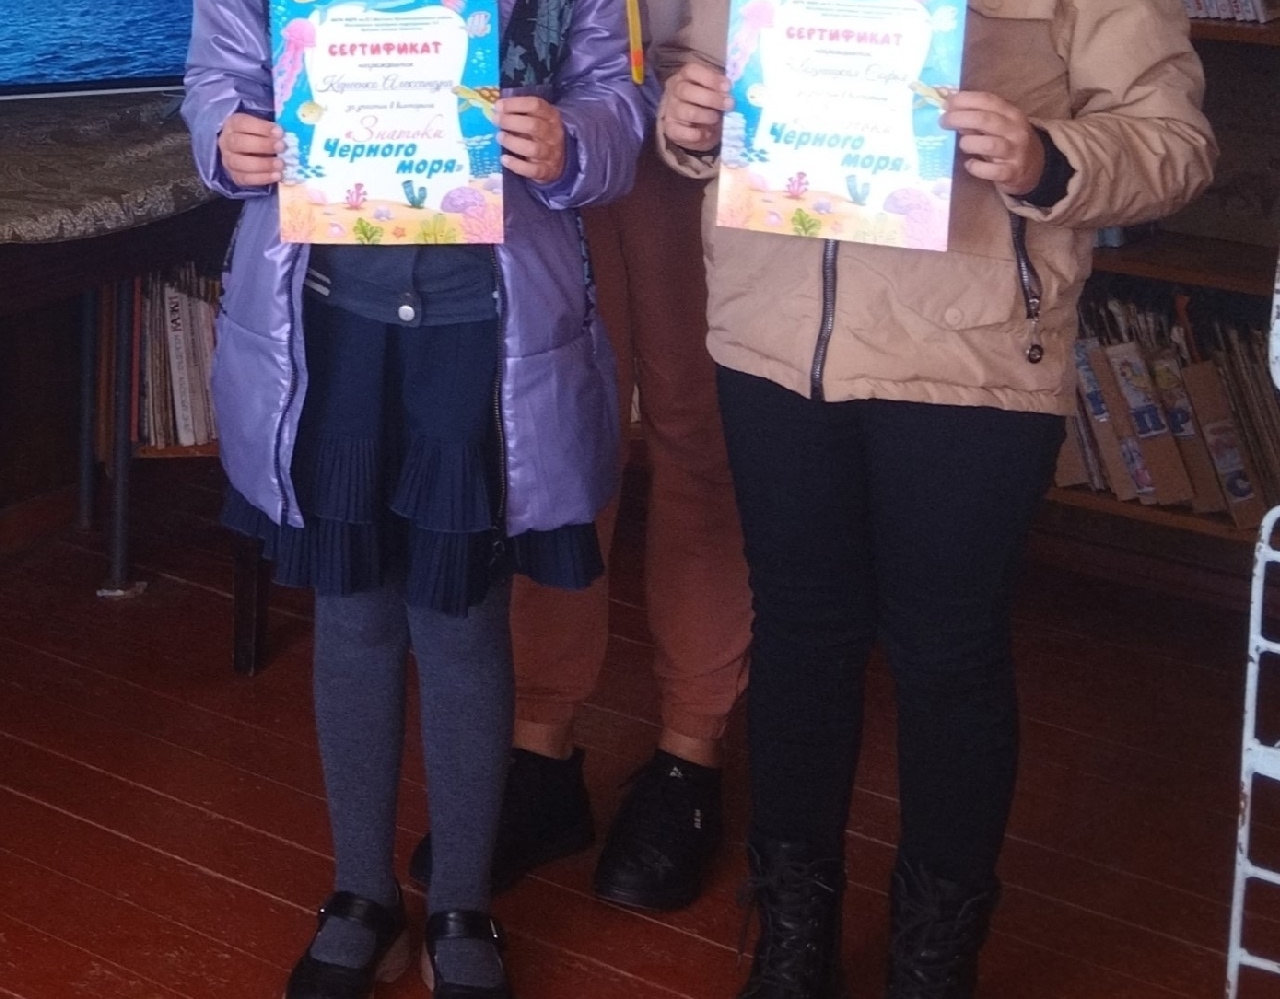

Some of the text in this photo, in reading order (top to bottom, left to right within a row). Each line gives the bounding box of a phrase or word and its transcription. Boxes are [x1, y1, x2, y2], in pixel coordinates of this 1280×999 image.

[786, 26, 904, 47] СЕРТИФИКАТ
[328, 41, 442, 57] СЕРТИФИКАТ
[770, 122, 865, 150] Черного
[324, 138, 417, 162] Черного
